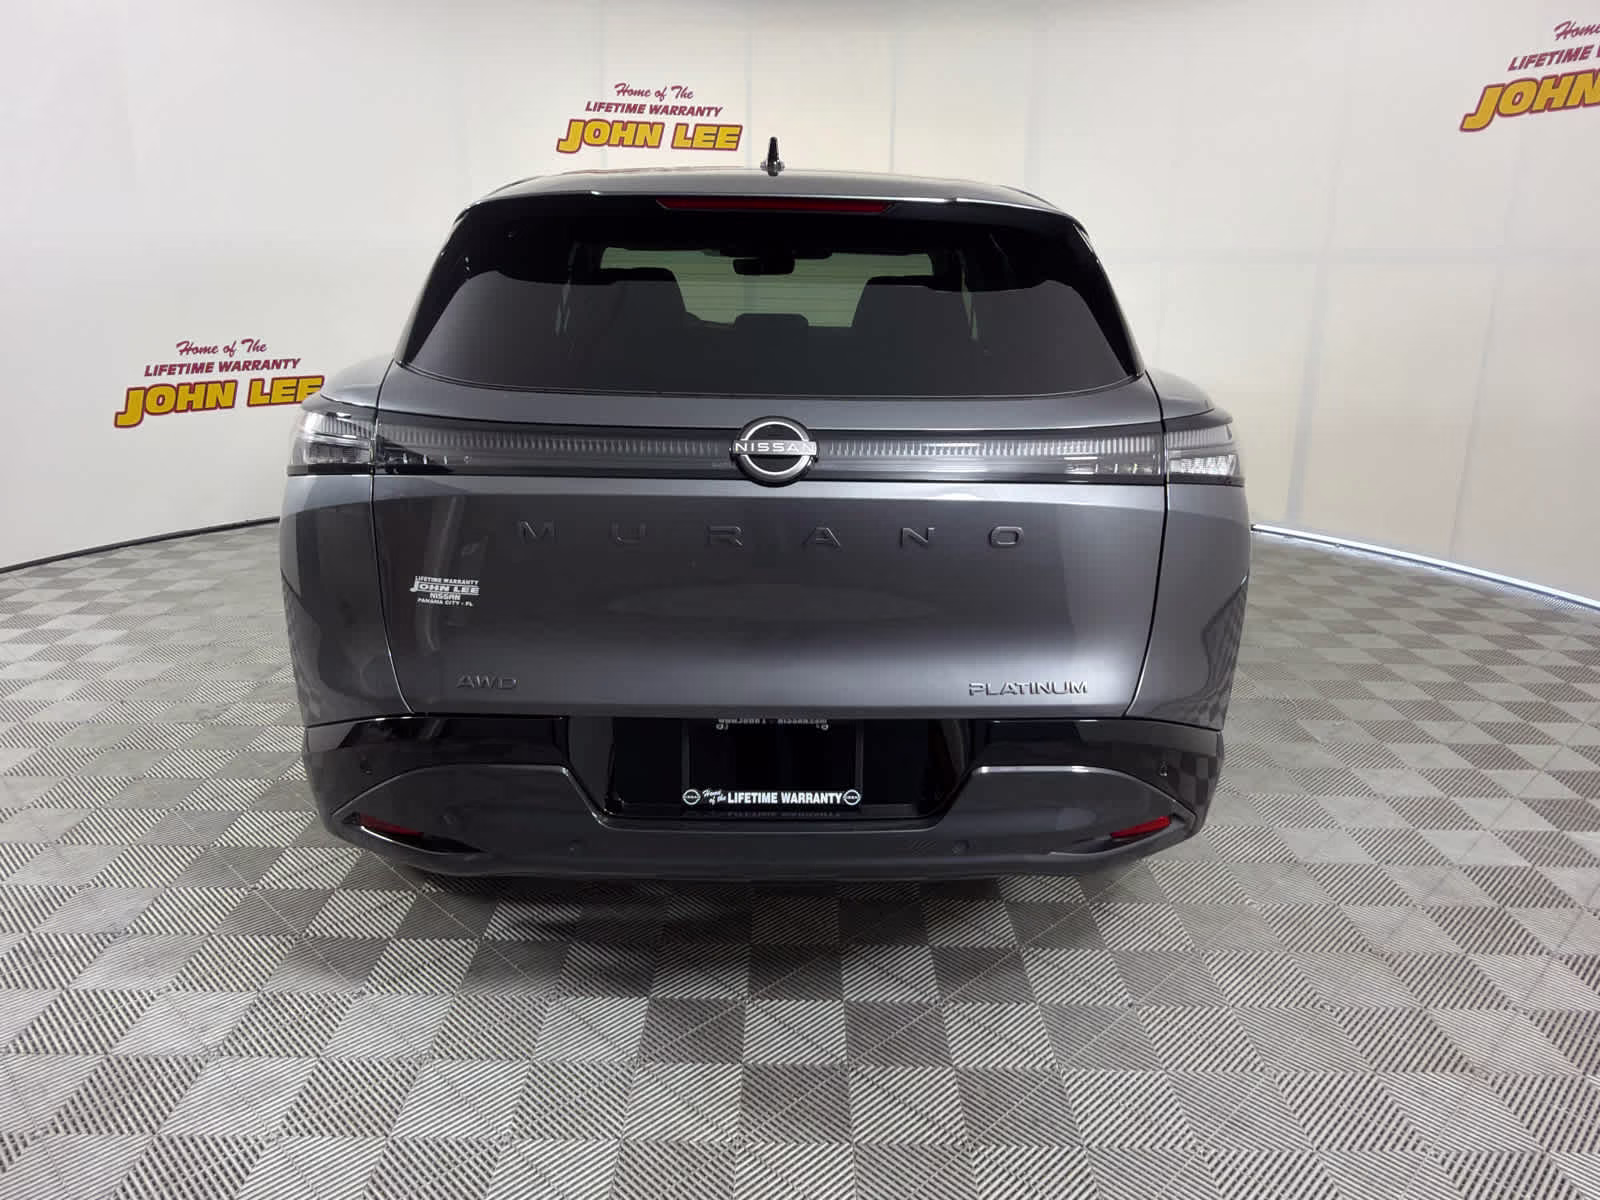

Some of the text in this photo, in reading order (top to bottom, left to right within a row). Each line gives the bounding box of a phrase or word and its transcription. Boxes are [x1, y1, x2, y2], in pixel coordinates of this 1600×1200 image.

[1507, 44, 1595, 72] LIFETIME
[614, 82, 694, 102] Home of The
[1459, 68, 1600, 132] JOHN
[585, 101, 723, 118] LIFETIME WARRANTY
[556, 118, 743, 154] JOHN LEE
[175, 338, 267, 358] Home of The
[143, 358, 301, 377] LIFETIME WARRANTY
[114, 375, 325, 428] JOHN LEE
[735, 442, 816, 453] NISSAN
[518, 520, 1025, 548] MURANO
[409, 580, 480, 595] JOHN LEE
[456, 674, 520, 689] AWD
[968, 680, 1088, 696] PLATINUM
[727, 791, 843, 804] LIFETIME WARRANTY
